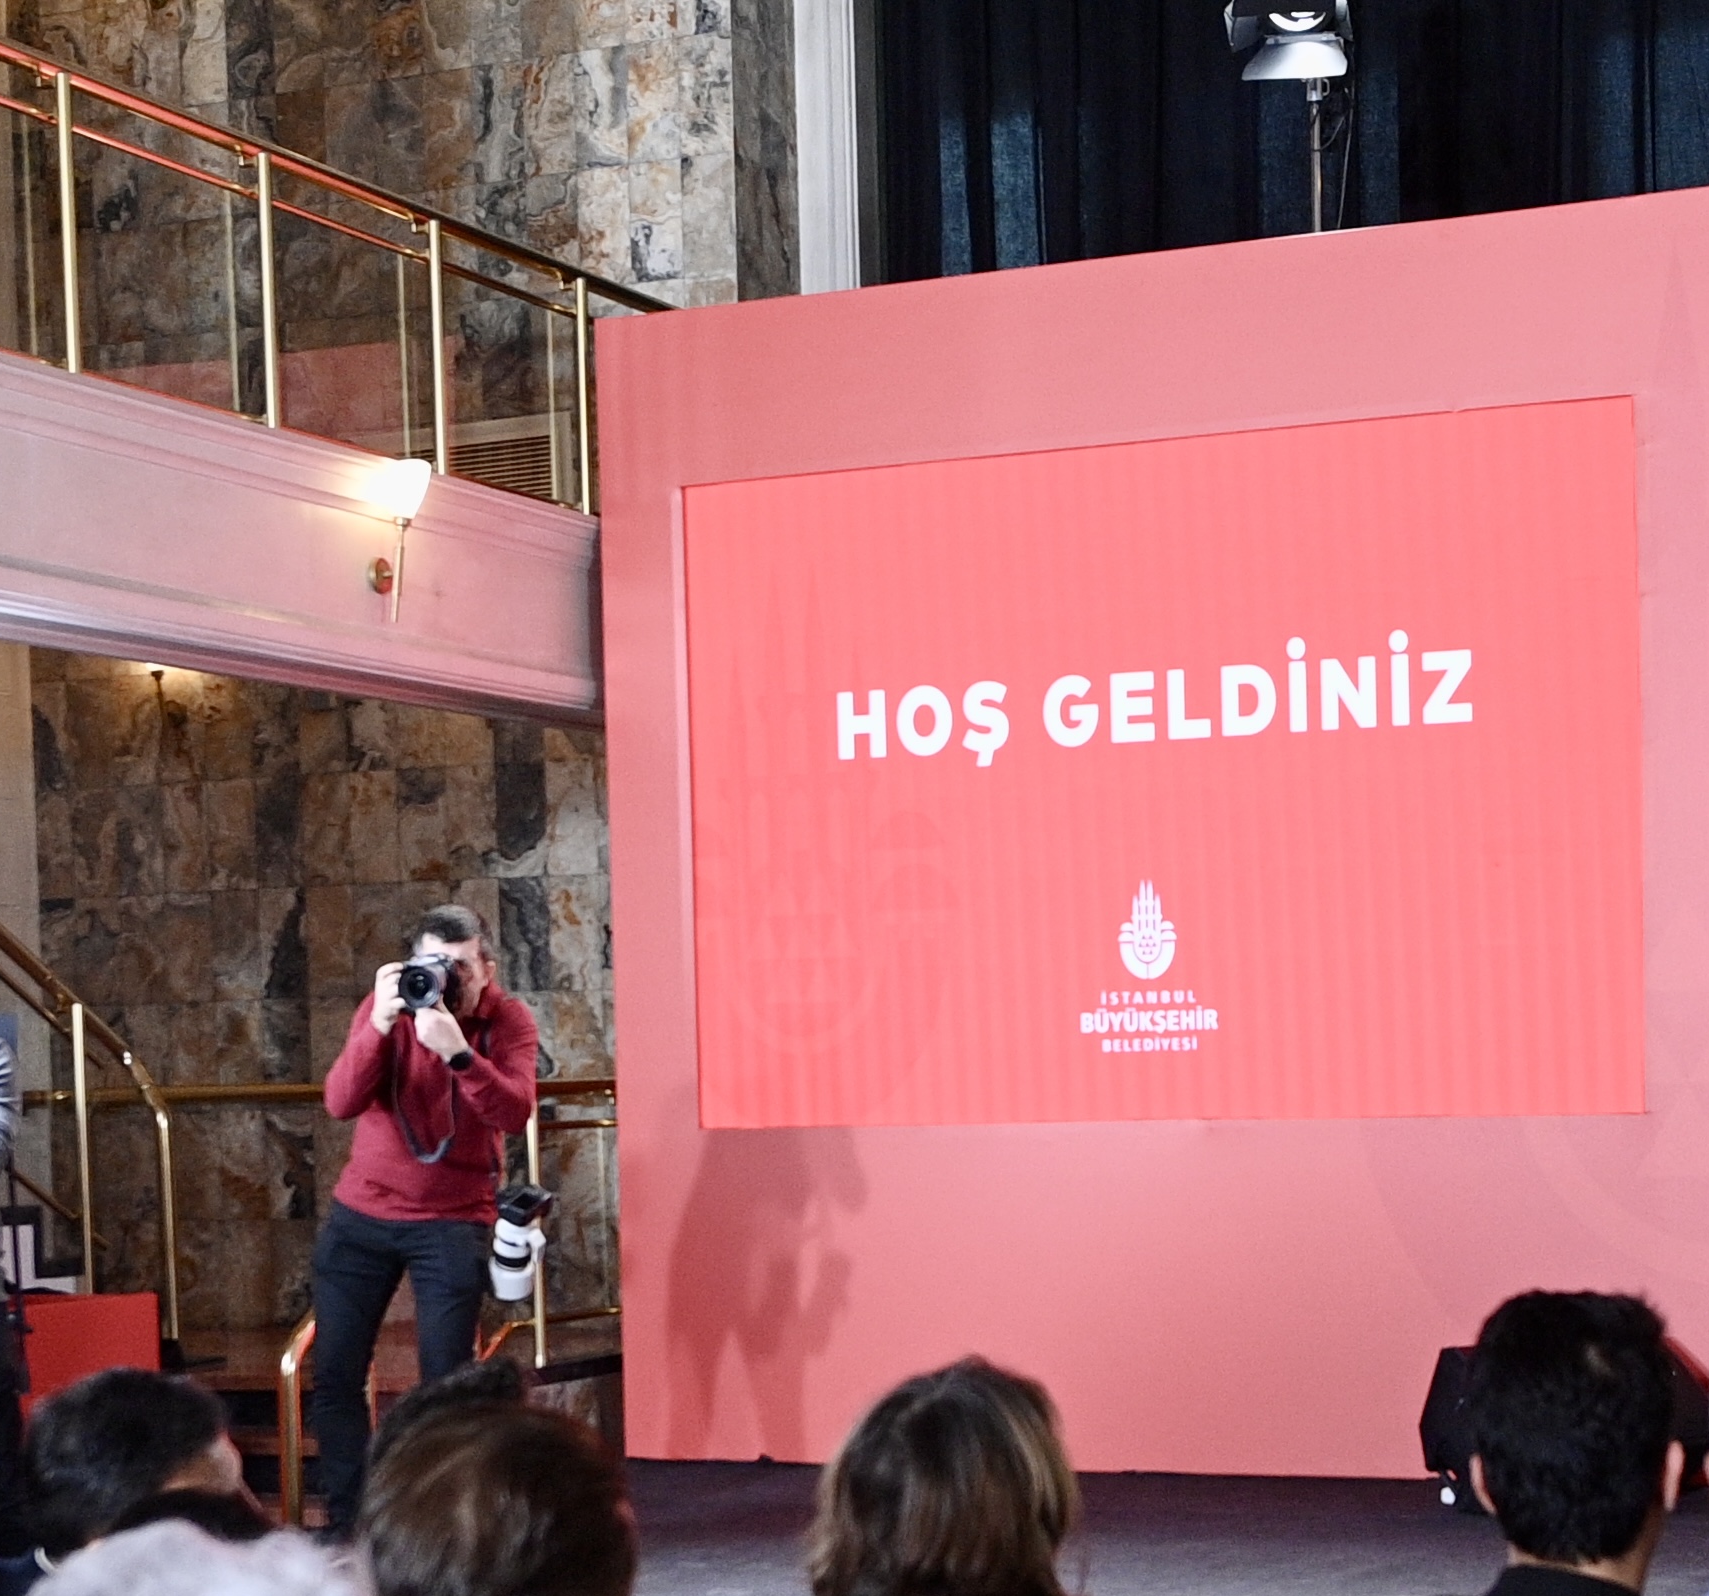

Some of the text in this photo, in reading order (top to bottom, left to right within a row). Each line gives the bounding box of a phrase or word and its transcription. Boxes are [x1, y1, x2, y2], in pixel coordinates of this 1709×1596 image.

[835, 629, 1474, 768] HOŞ GELDİNİZ
[1100, 990, 1196, 1006] İSTANBUL
[1080, 1005, 1219, 1034] BÜYÜKŞEHİR
[1101, 1036, 1198, 1053] BELEDİYESİ
